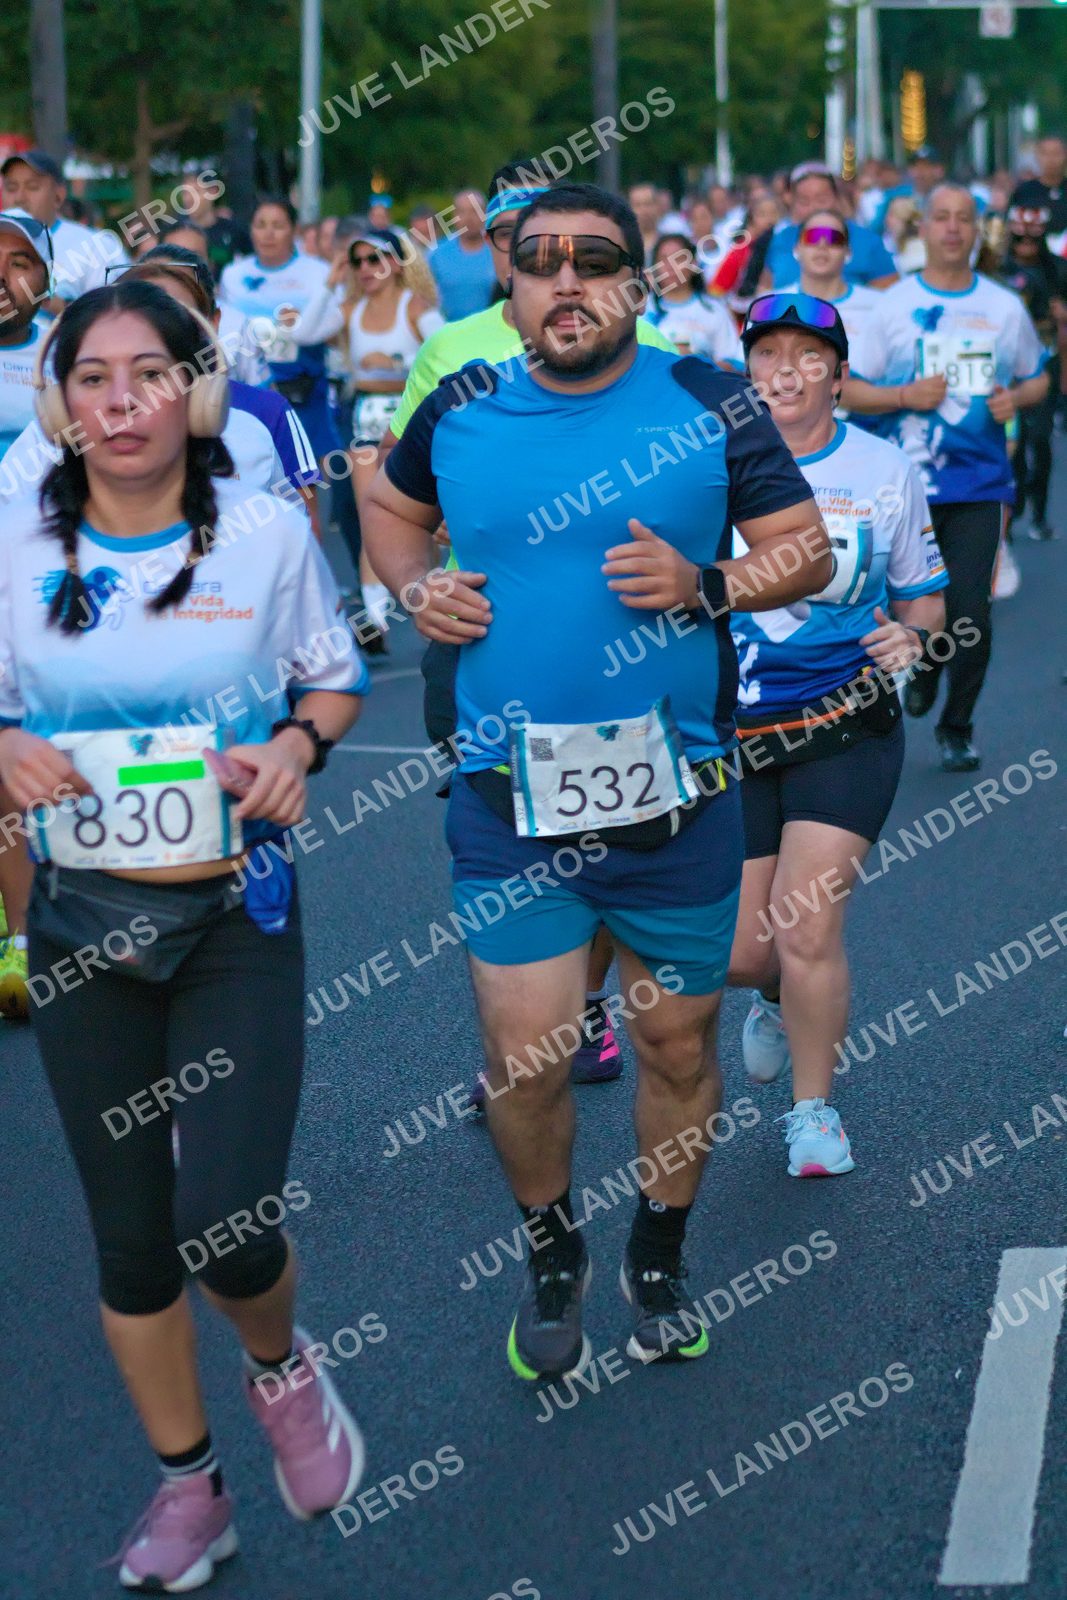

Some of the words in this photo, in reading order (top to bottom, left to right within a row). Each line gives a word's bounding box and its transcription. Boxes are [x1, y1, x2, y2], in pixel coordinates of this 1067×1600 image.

[830, 497, 853, 507] Vida
[819, 506, 872, 517] ntegridad
[144, 581, 221, 594] Caera
[189, 595, 225, 607] Vida
[174, 607, 254, 623] Integridad
[556, 762, 660, 817] 532
[73, 787, 193, 849] 830
